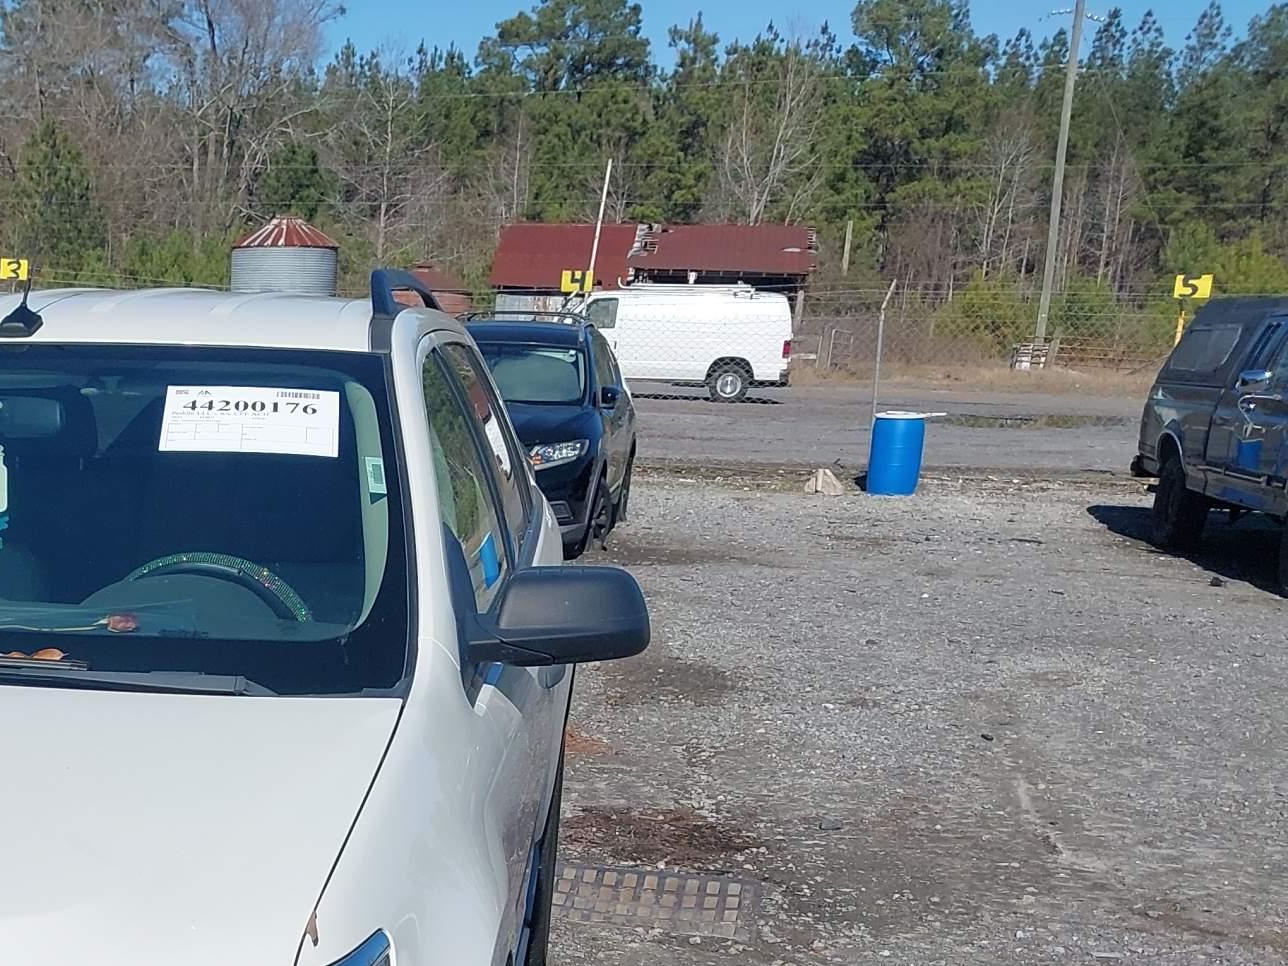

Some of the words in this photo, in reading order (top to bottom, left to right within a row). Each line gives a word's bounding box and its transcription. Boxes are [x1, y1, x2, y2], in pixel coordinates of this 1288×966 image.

[7, 260, 22, 279] 3
[570, 270, 587, 292] 4
[1180, 274, 1202, 297] 5
[182, 399, 318, 416] 44200176
